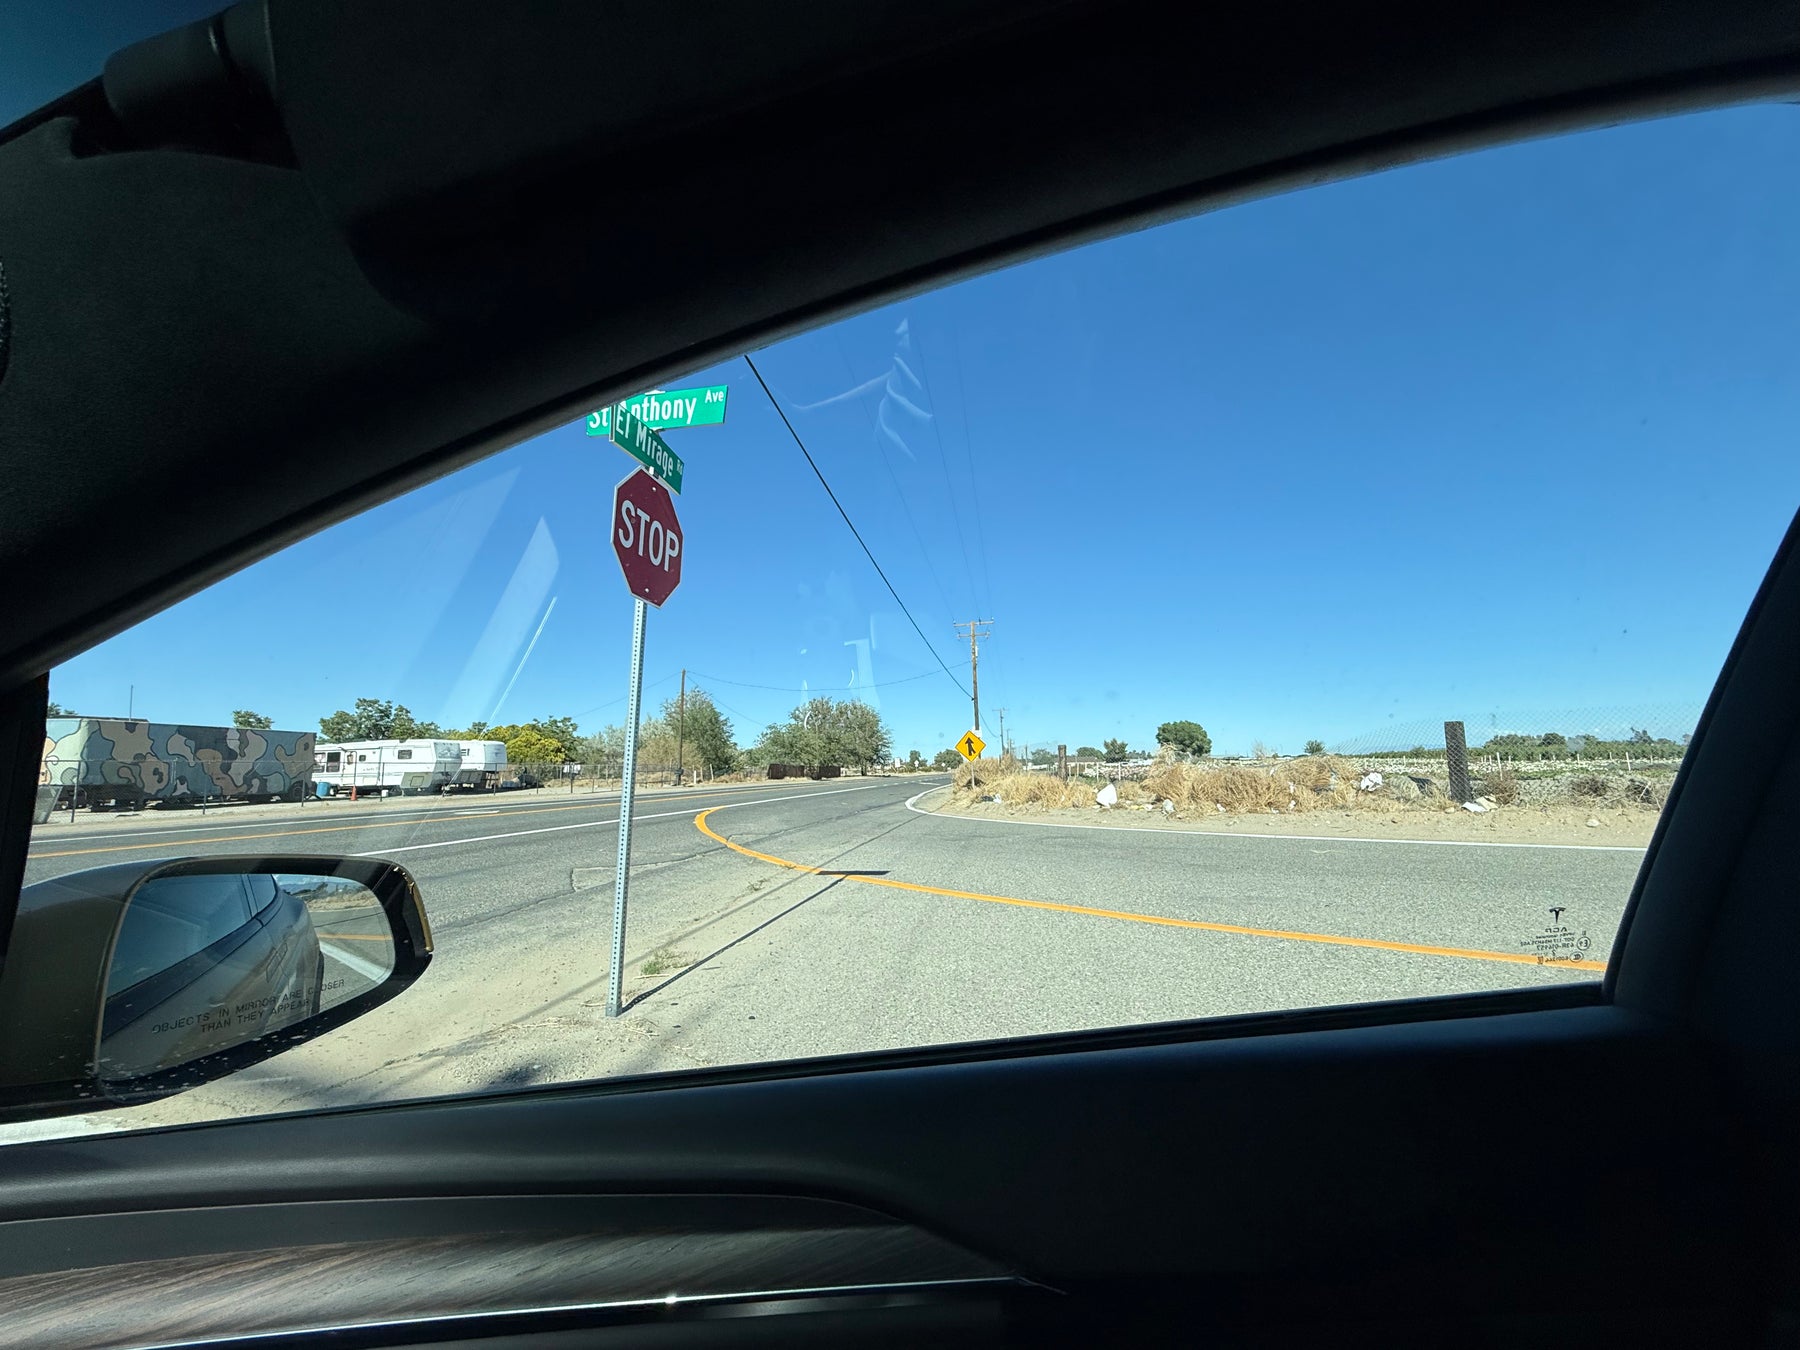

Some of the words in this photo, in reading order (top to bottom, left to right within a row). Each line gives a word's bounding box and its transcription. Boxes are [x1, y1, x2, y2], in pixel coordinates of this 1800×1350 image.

[620, 396, 697, 424] nthony
[704, 389, 724, 404] Ave
[616, 404, 630, 439] El
[636, 421, 674, 478] Mirage
[676, 459, 683, 475] Rd
[618, 500, 680, 572] STOP
[152, 1012, 210, 1034] OBJECTS
[219, 1008, 229, 1017] IN
[235, 996, 276, 1014] MIRROR
[283, 989, 301, 1001] ARE
[307, 979, 345, 995] COSER
[201, 1018, 231, 1033] THAN
[237, 1010, 264, 1024] THEY
[271, 998, 310, 1015] APPEAR
